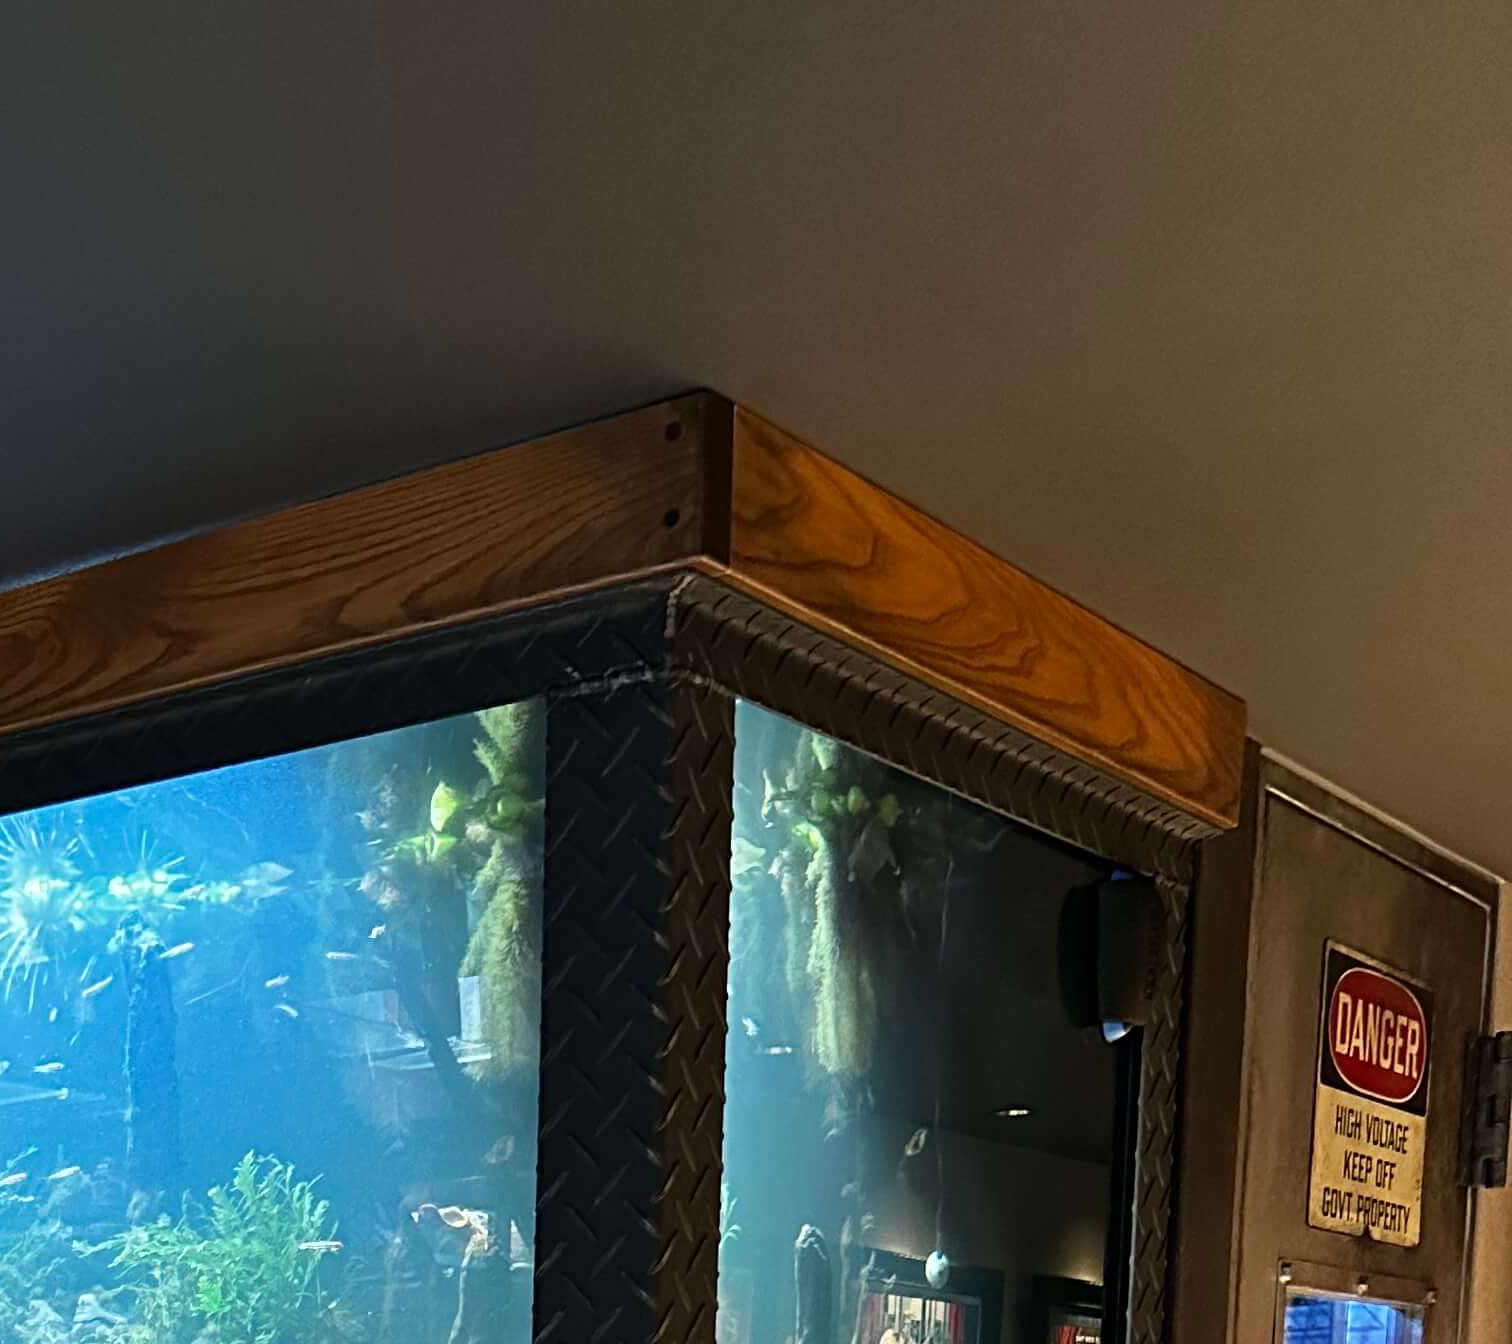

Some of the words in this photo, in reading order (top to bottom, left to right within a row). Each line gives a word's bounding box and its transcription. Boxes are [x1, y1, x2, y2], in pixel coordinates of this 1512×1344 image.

[1335, 992, 1422, 1080] DANGER
[1335, 1104, 1362, 1140] HIGH
[1366, 1112, 1409, 1154] VOLTAGE
[1343, 1149, 1373, 1184] KEEP
[1375, 1158, 1396, 1190] OFF
[1356, 1195, 1410, 1234] PROPERTY
